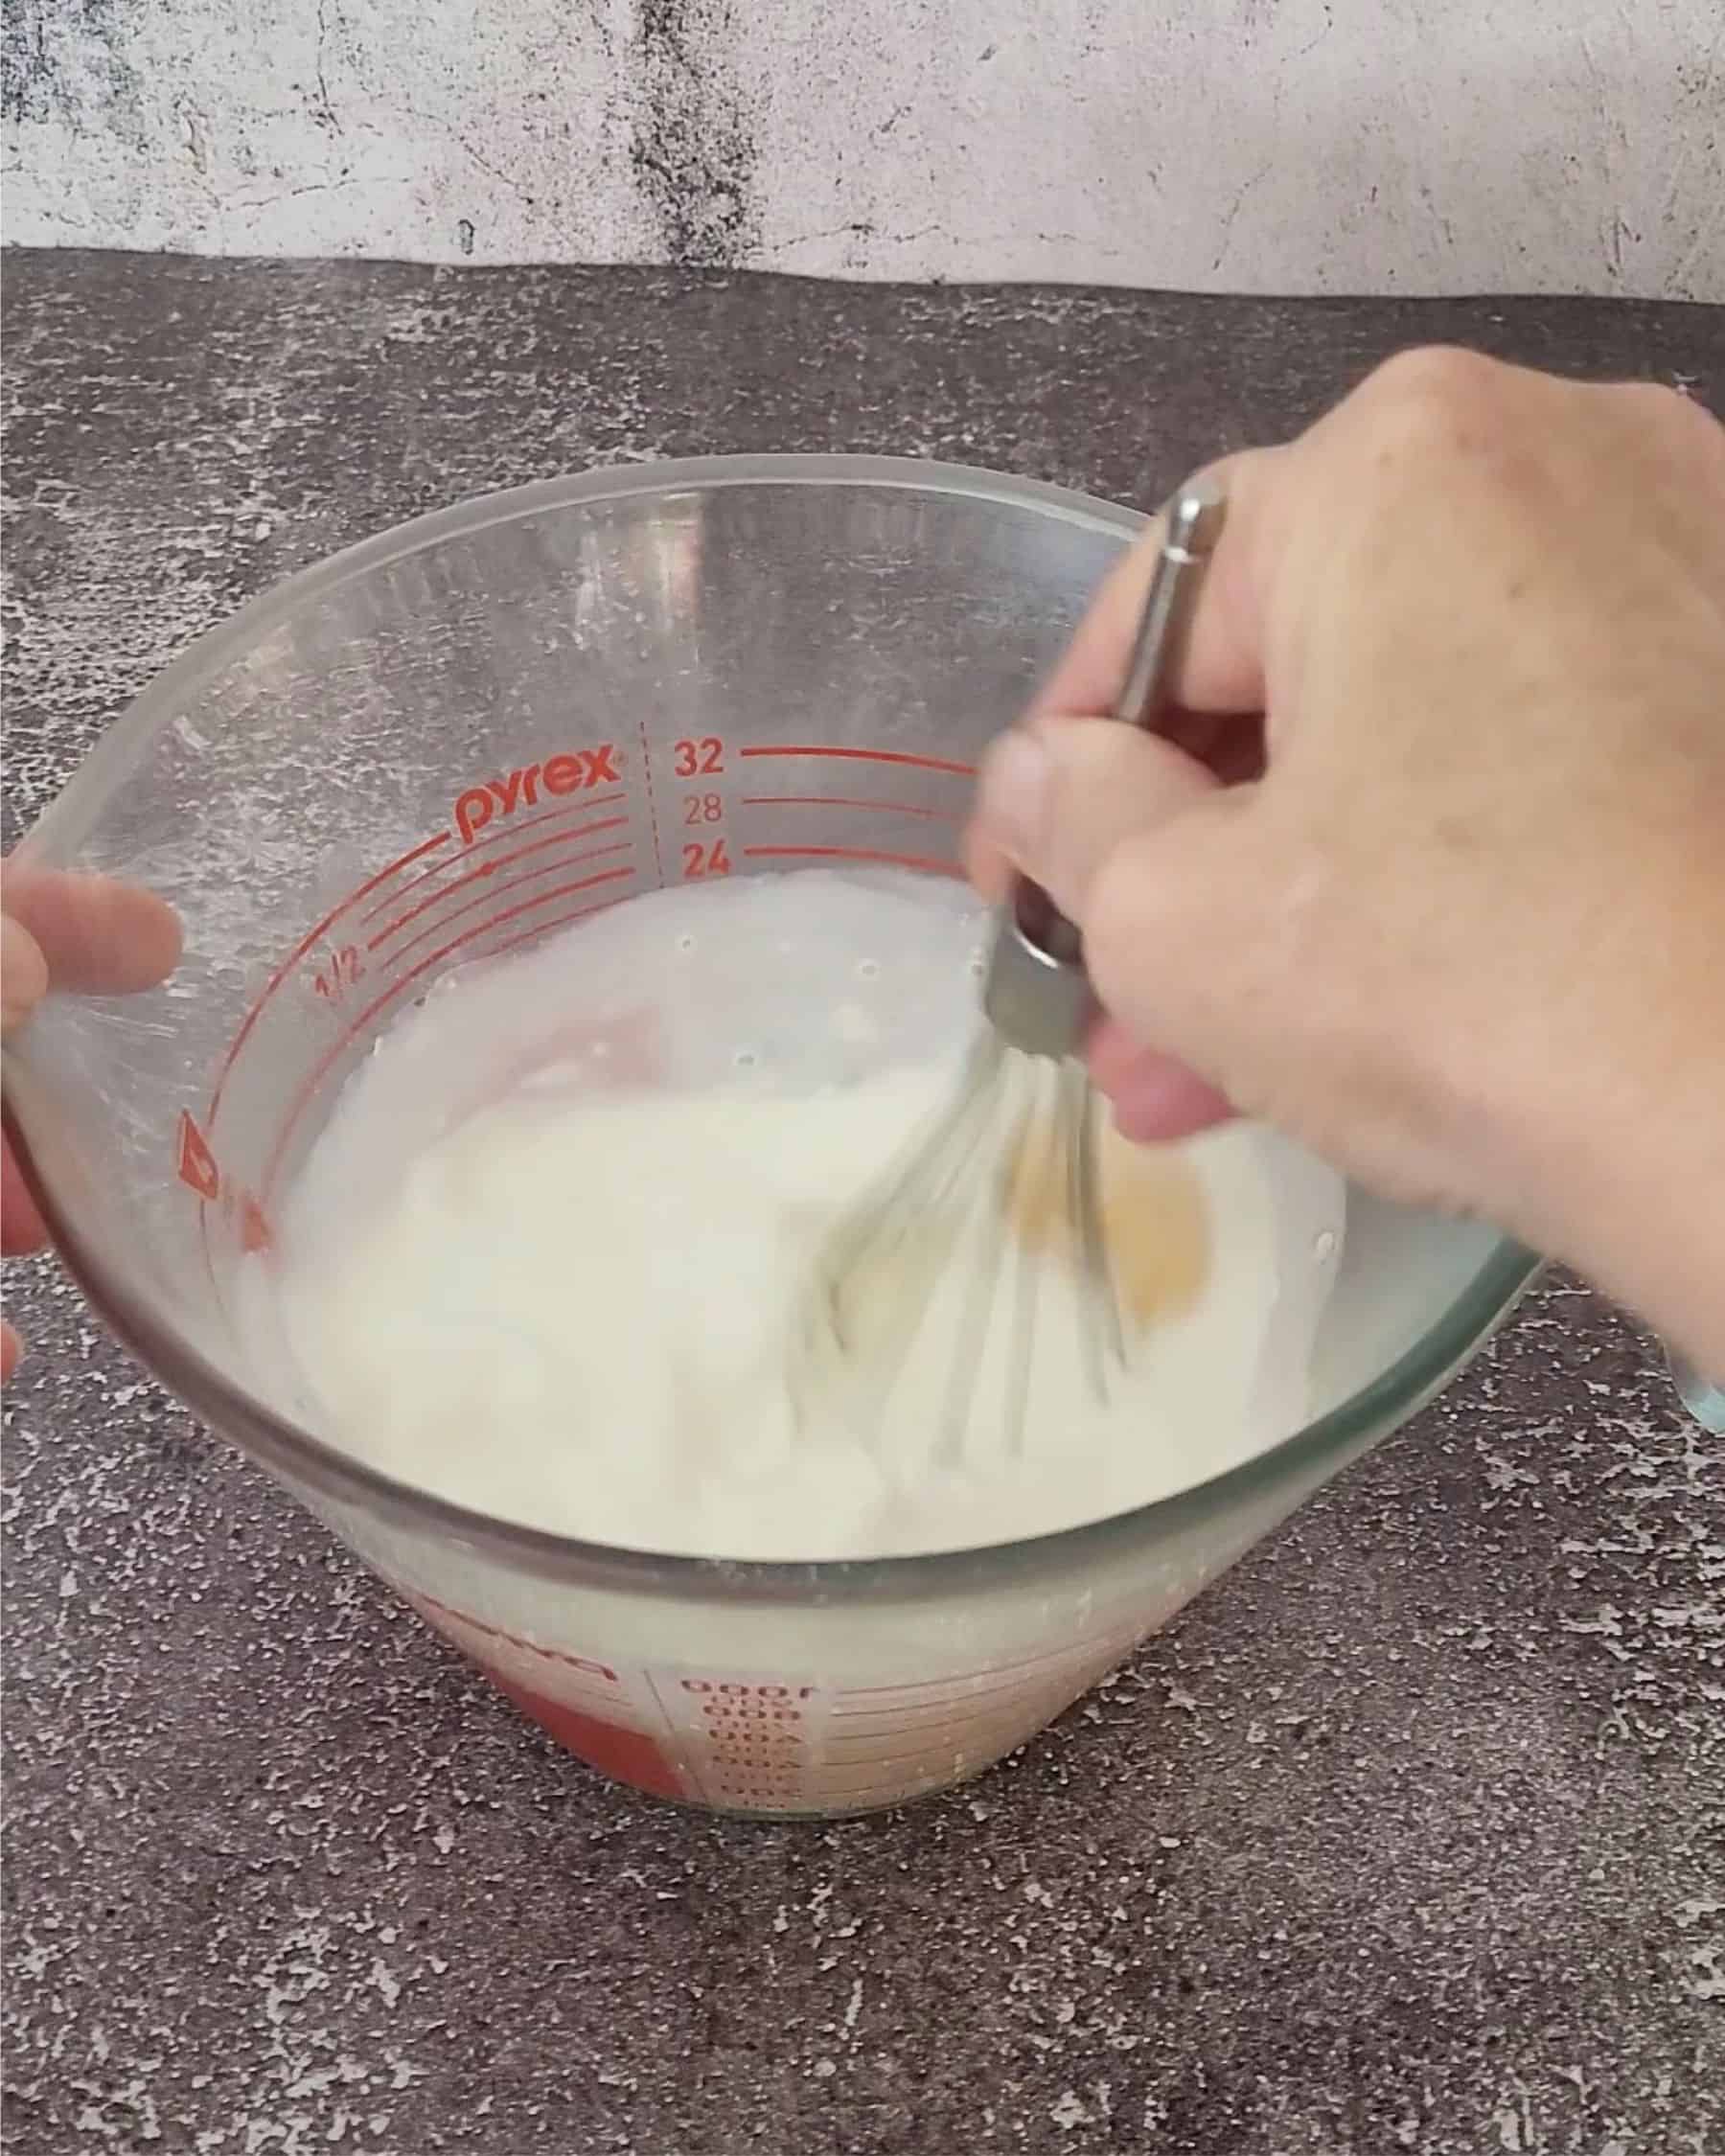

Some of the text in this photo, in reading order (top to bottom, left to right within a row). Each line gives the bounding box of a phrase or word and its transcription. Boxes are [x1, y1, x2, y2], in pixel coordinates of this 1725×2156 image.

[675, 738, 724, 777] 32
[455, 745, 621, 843] pyrex
[683, 792, 722, 825] 28
[682, 837, 731, 878] 24
